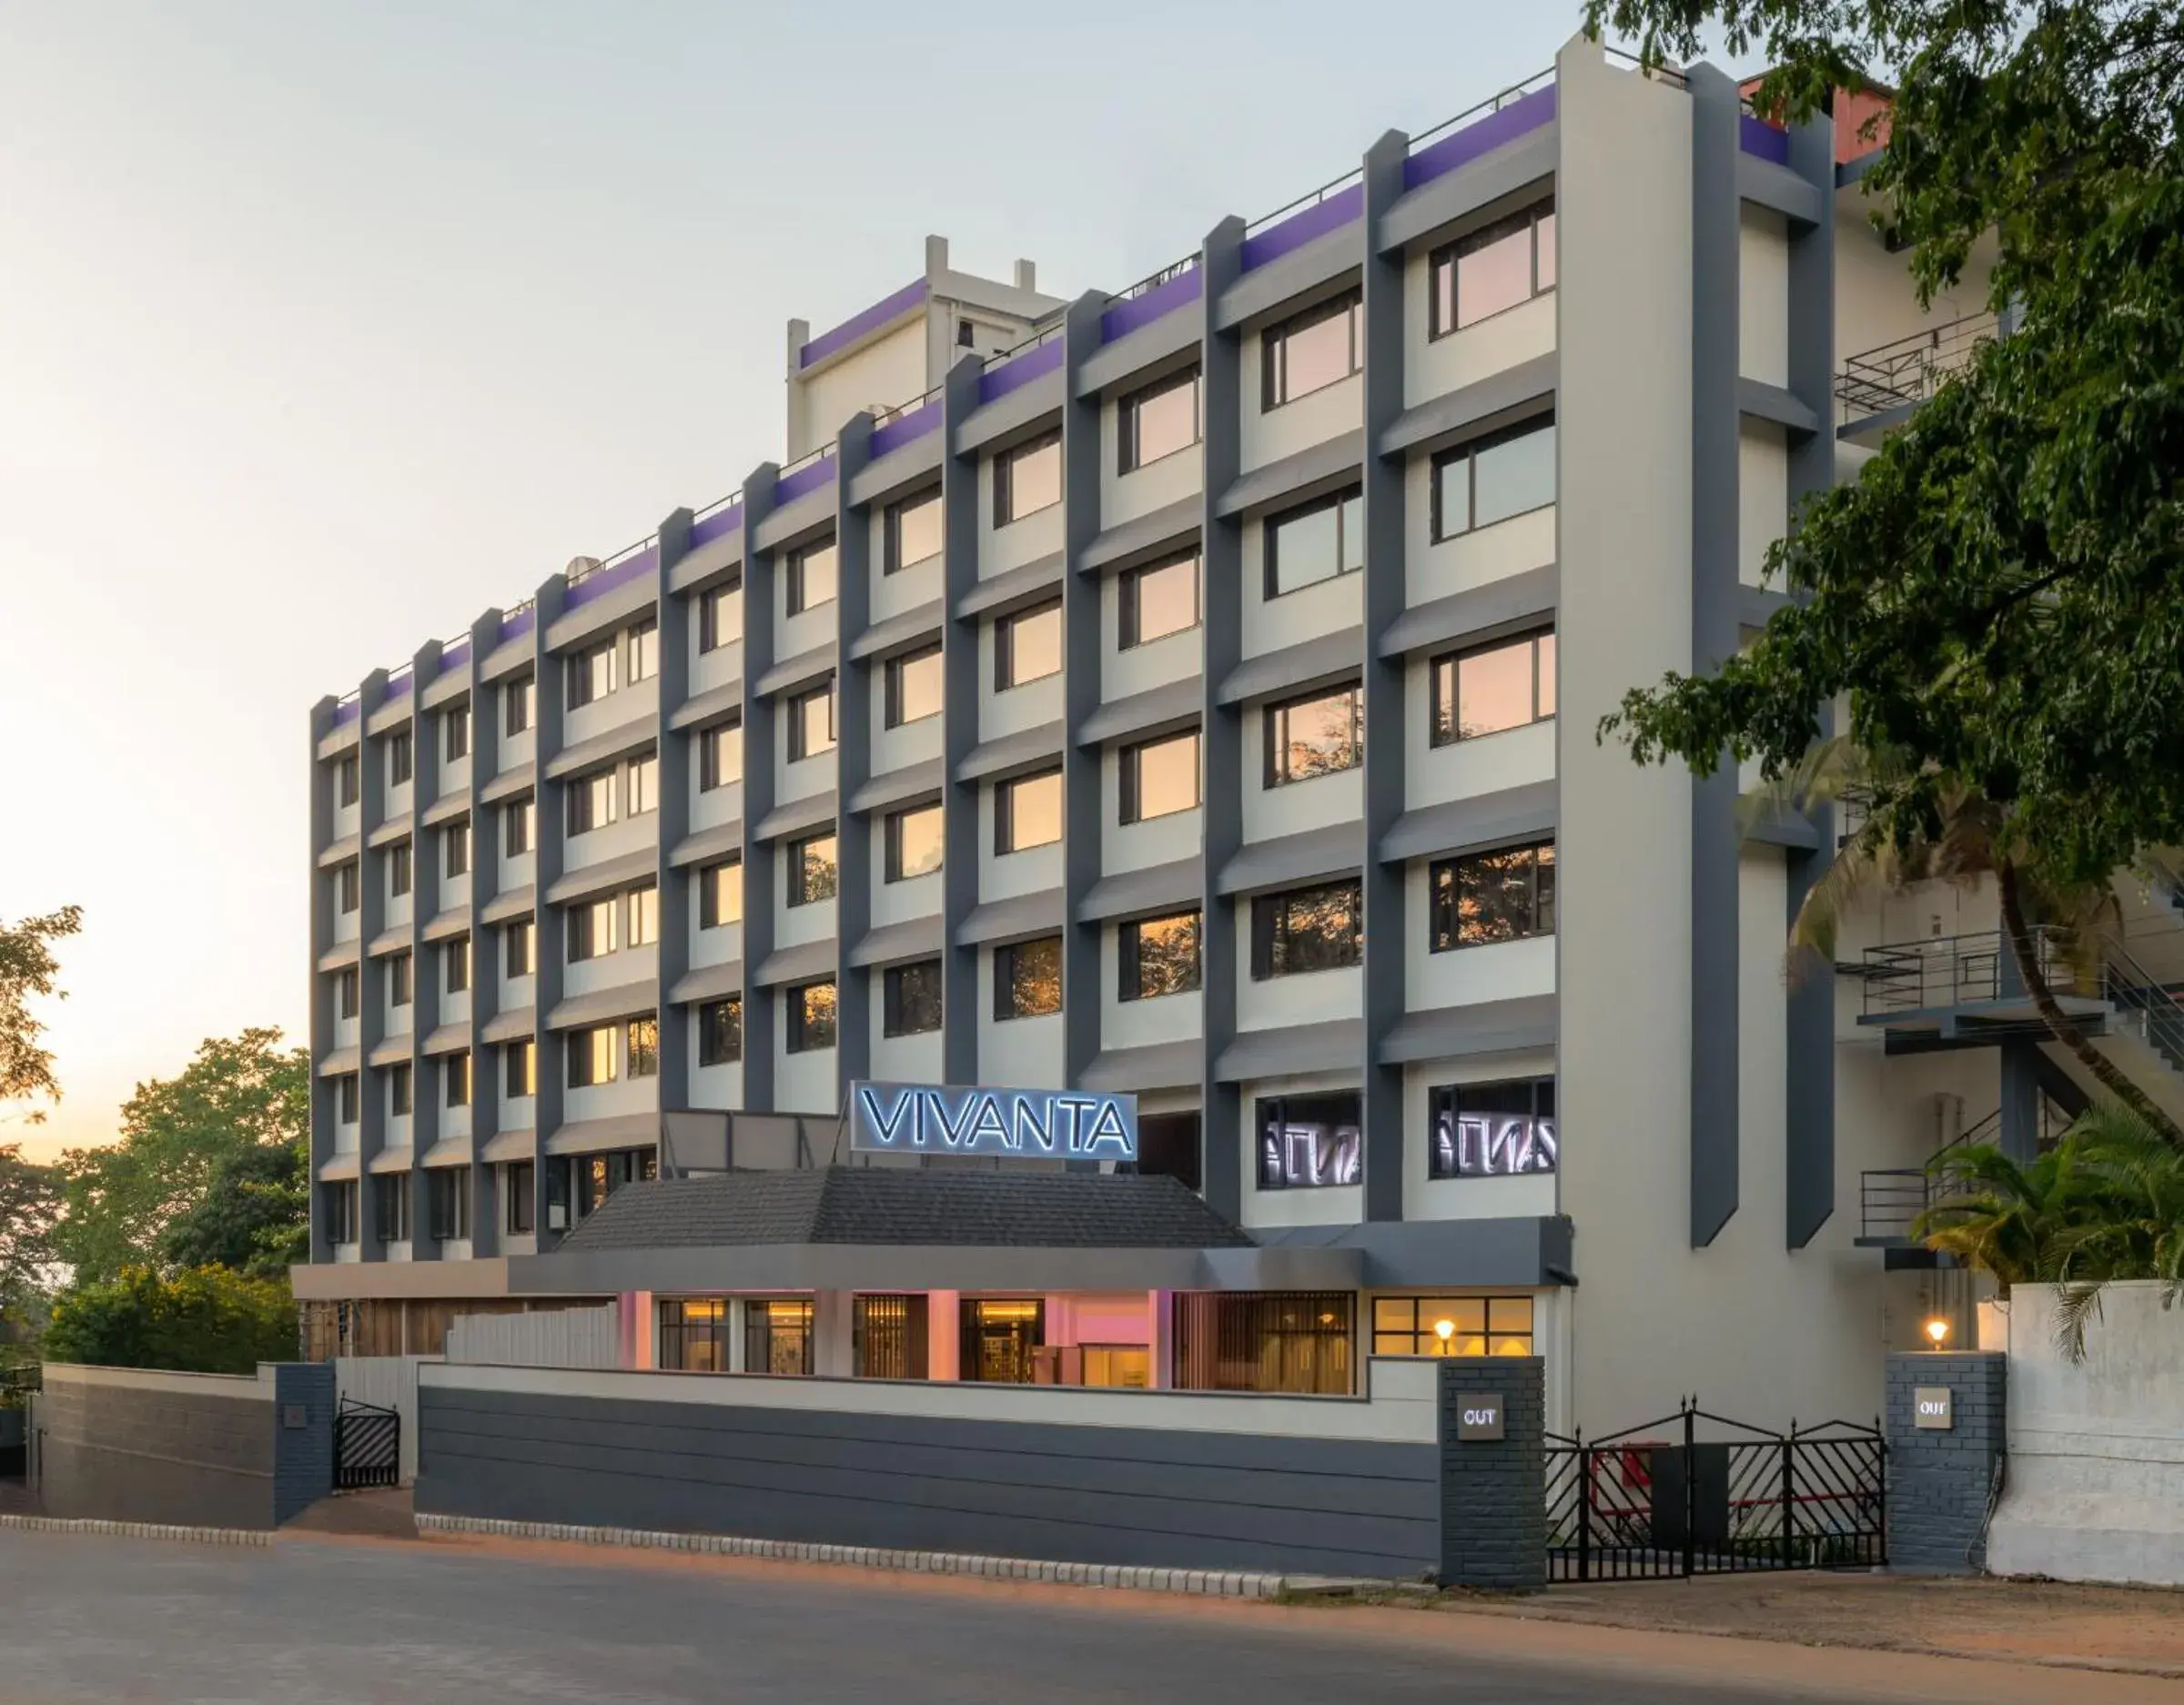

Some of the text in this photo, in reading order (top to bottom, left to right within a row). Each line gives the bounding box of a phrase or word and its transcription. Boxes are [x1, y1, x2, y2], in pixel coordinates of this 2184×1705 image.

[862, 1089, 1134, 1154] VIVANTA
[1463, 1408, 1497, 1426] OUT
[1920, 1401, 1946, 1415] OUT
